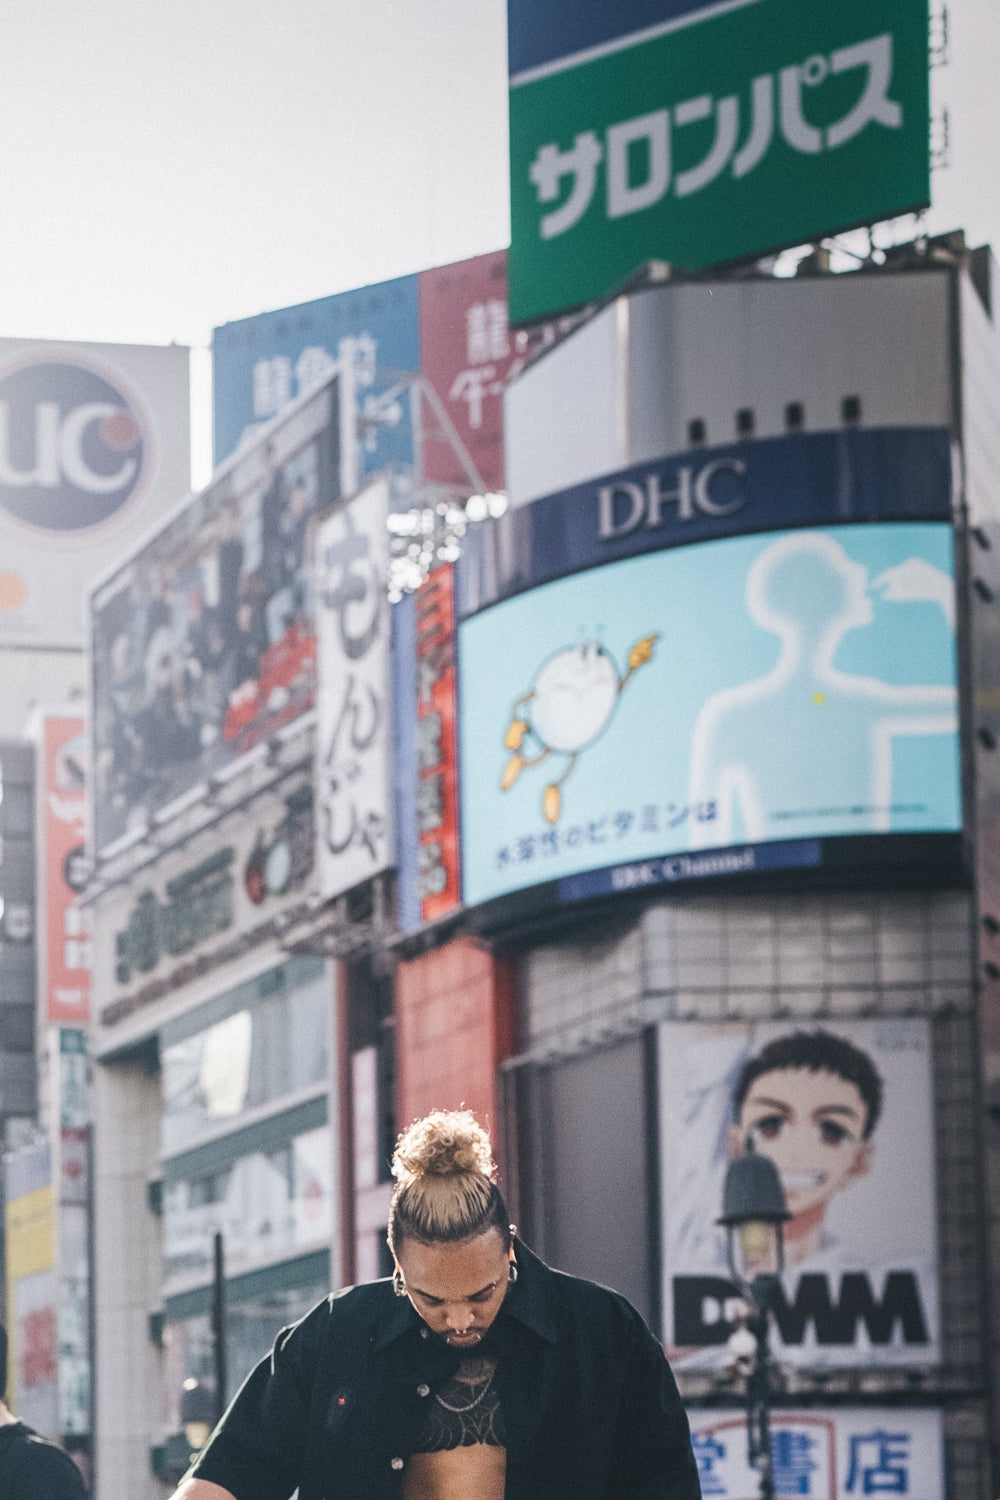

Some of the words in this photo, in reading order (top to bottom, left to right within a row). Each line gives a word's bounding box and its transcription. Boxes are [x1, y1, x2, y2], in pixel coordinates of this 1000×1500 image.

[529, 32, 902, 240] サロンパス
[601, 457, 747, 538] DHC
